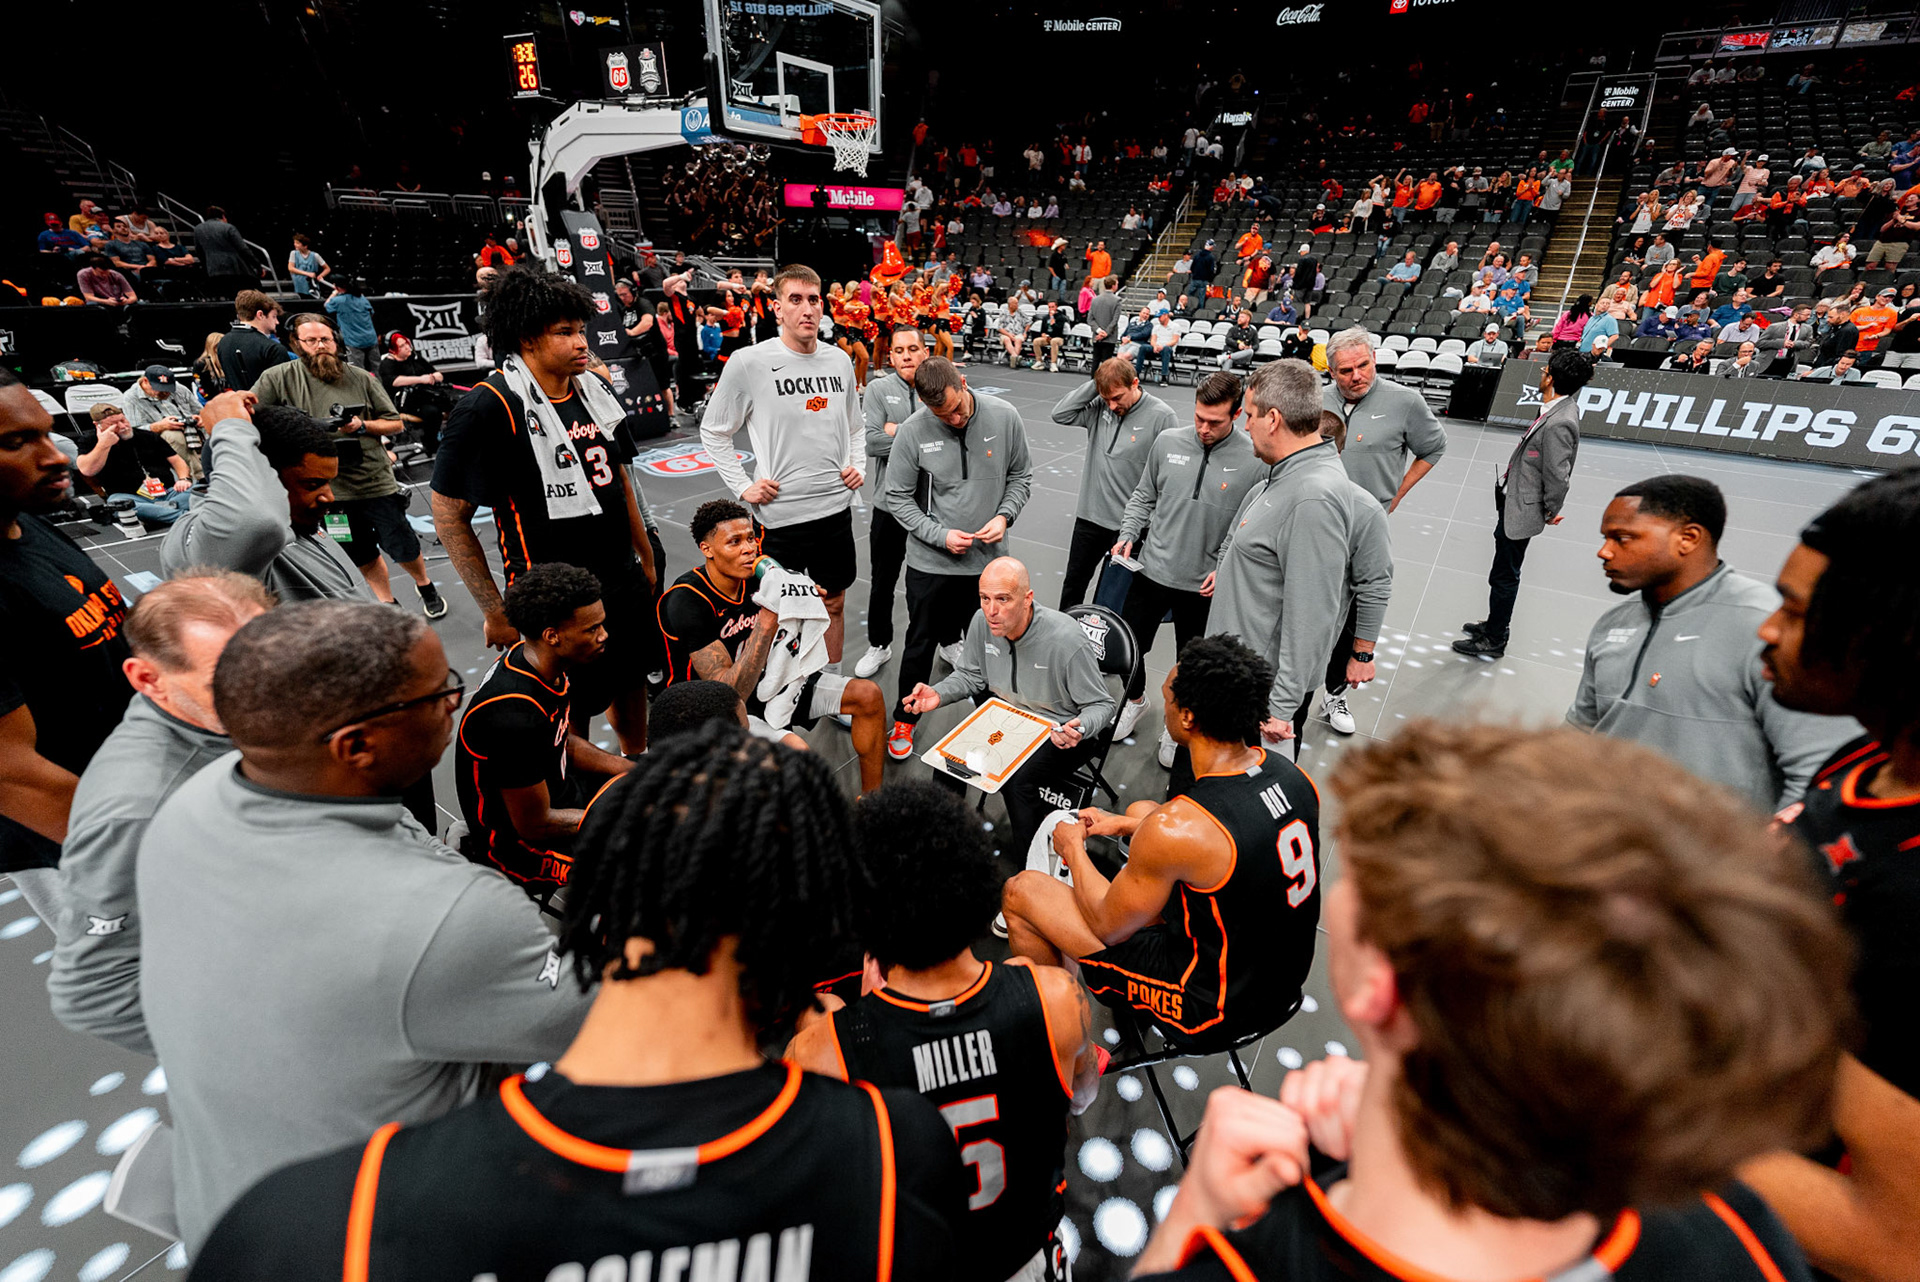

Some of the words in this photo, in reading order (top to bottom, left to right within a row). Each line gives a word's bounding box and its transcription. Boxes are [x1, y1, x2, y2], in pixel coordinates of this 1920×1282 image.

[1085, 20, 1120, 31] CENTER
[519, 64, 537, 89] 26
[613, 69, 626, 84] 66
[1601, 98, 1634, 108] CENTER
[829, 189, 875, 207] Mobile
[420, 346, 474, 362] LEAGUE
[775, 377, 816, 396] LOCK
[816, 376, 829, 393] IT
[1577, 386, 1858, 448] PHILLIPS
[1866, 415, 1920, 457] 6
[546, 481, 578, 498] ADE
[1259, 782, 1293, 820] ROY
[1276, 818, 1317, 909] 9
[1127, 979, 1183, 1021] POKES
[911, 1029, 998, 1094] MILLER
